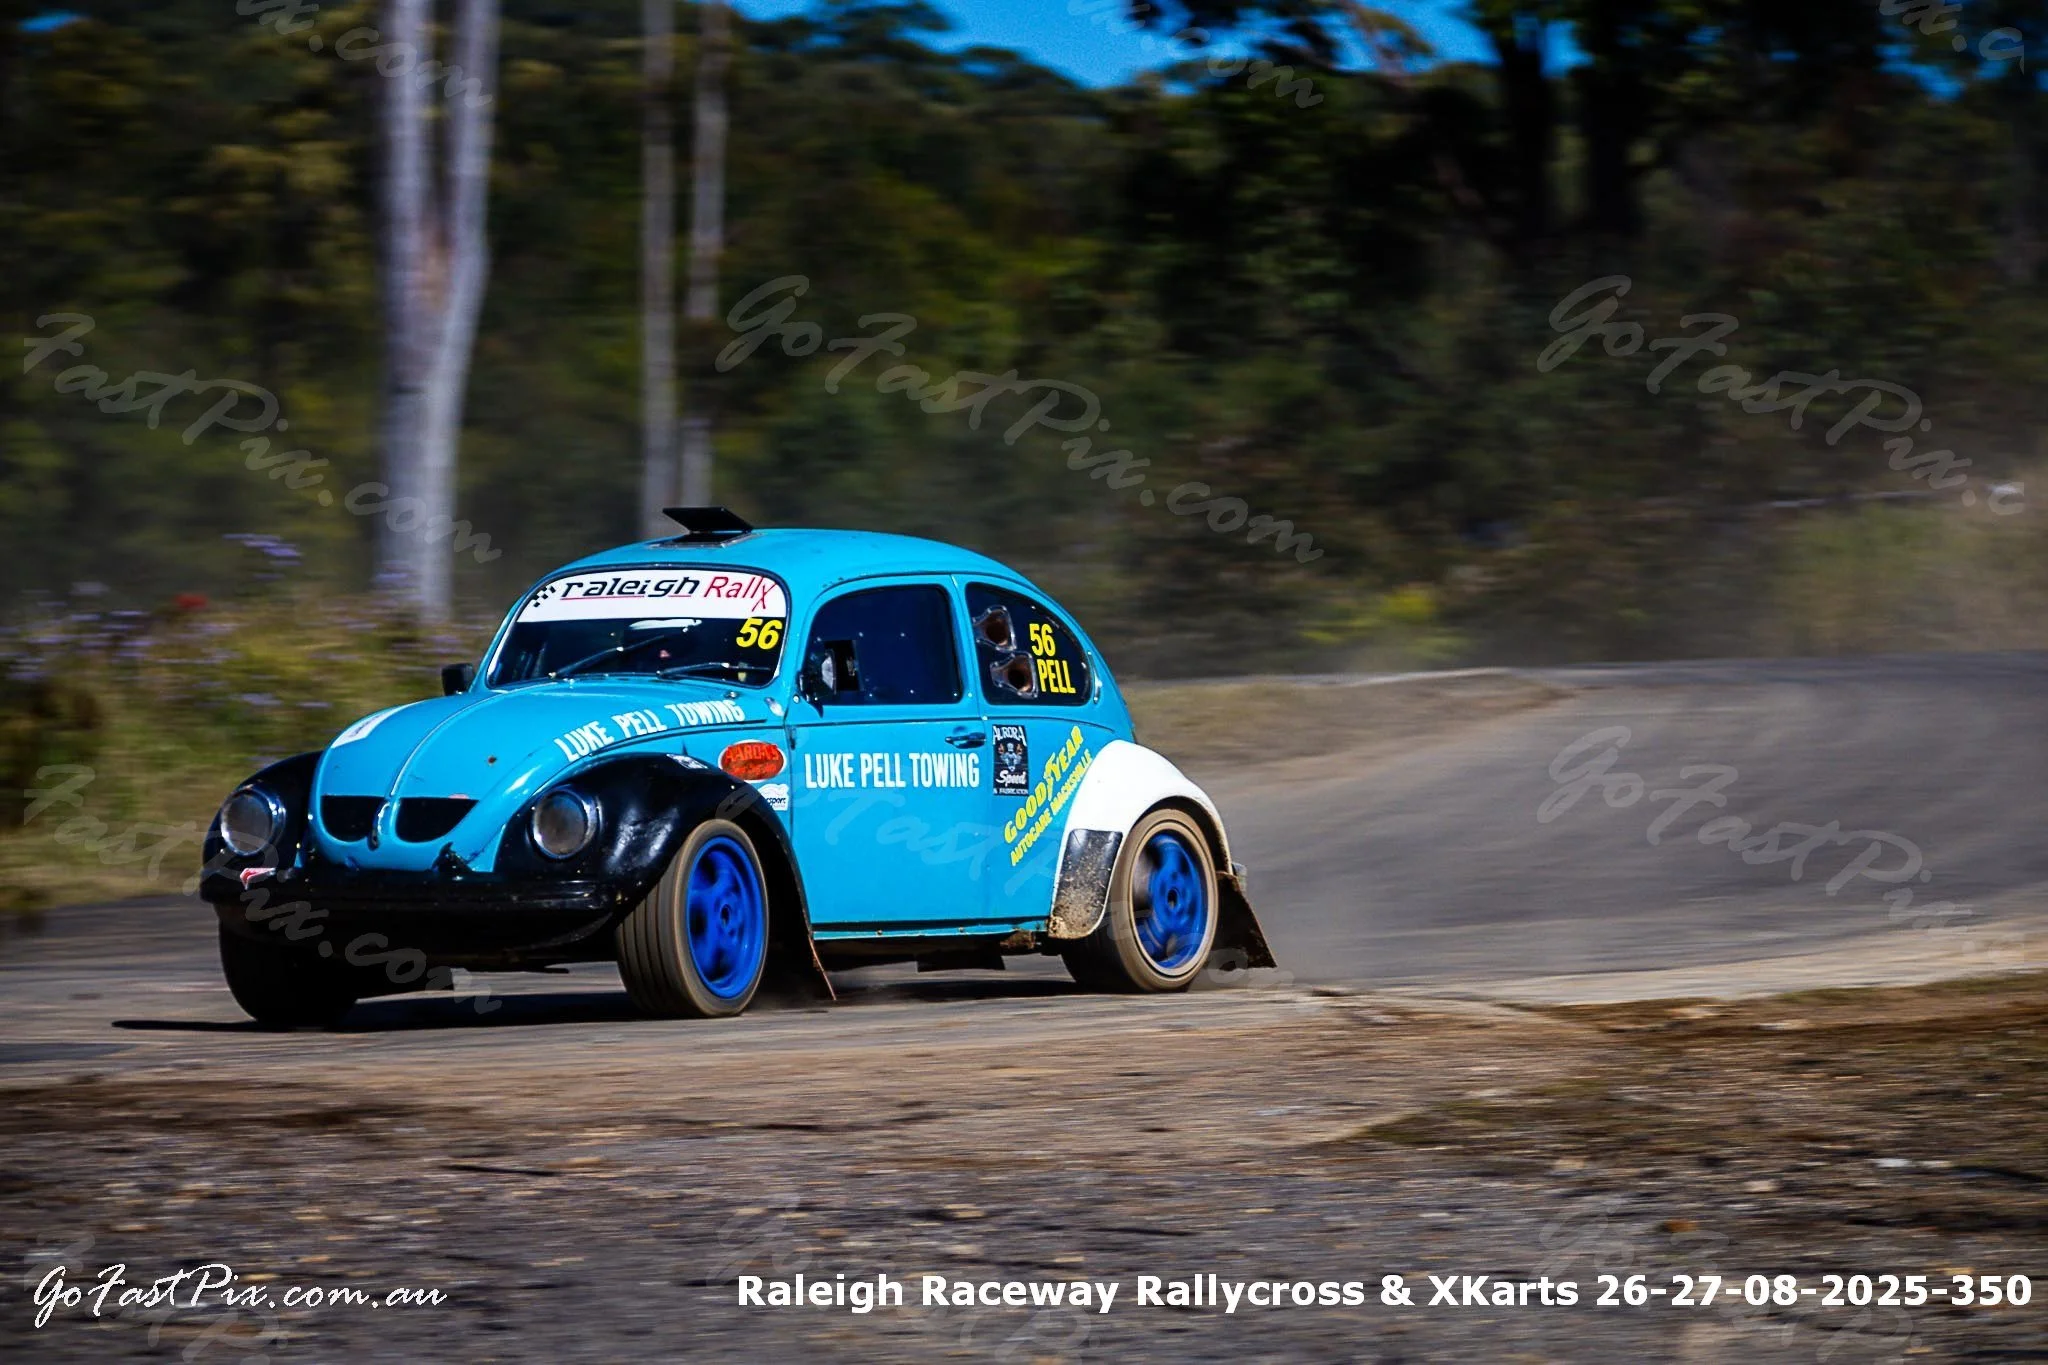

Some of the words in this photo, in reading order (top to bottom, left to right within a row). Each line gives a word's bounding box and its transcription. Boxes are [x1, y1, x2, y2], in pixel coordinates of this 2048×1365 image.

[561, 577, 700, 598] raleigh
[736, 617, 783, 650] 56
[1029, 623, 1055, 656] 56
[1037, 658, 1076, 694] PELL
[554, 720, 615, 762] LUKE
[611, 709, 668, 739] PELL
[664, 700, 746, 727] TOWING
[993, 725, 1027, 747] AURORA
[805, 753, 855, 788] LUKE
[861, 752, 906, 788] PELL
[909, 752, 980, 788] TOWING
